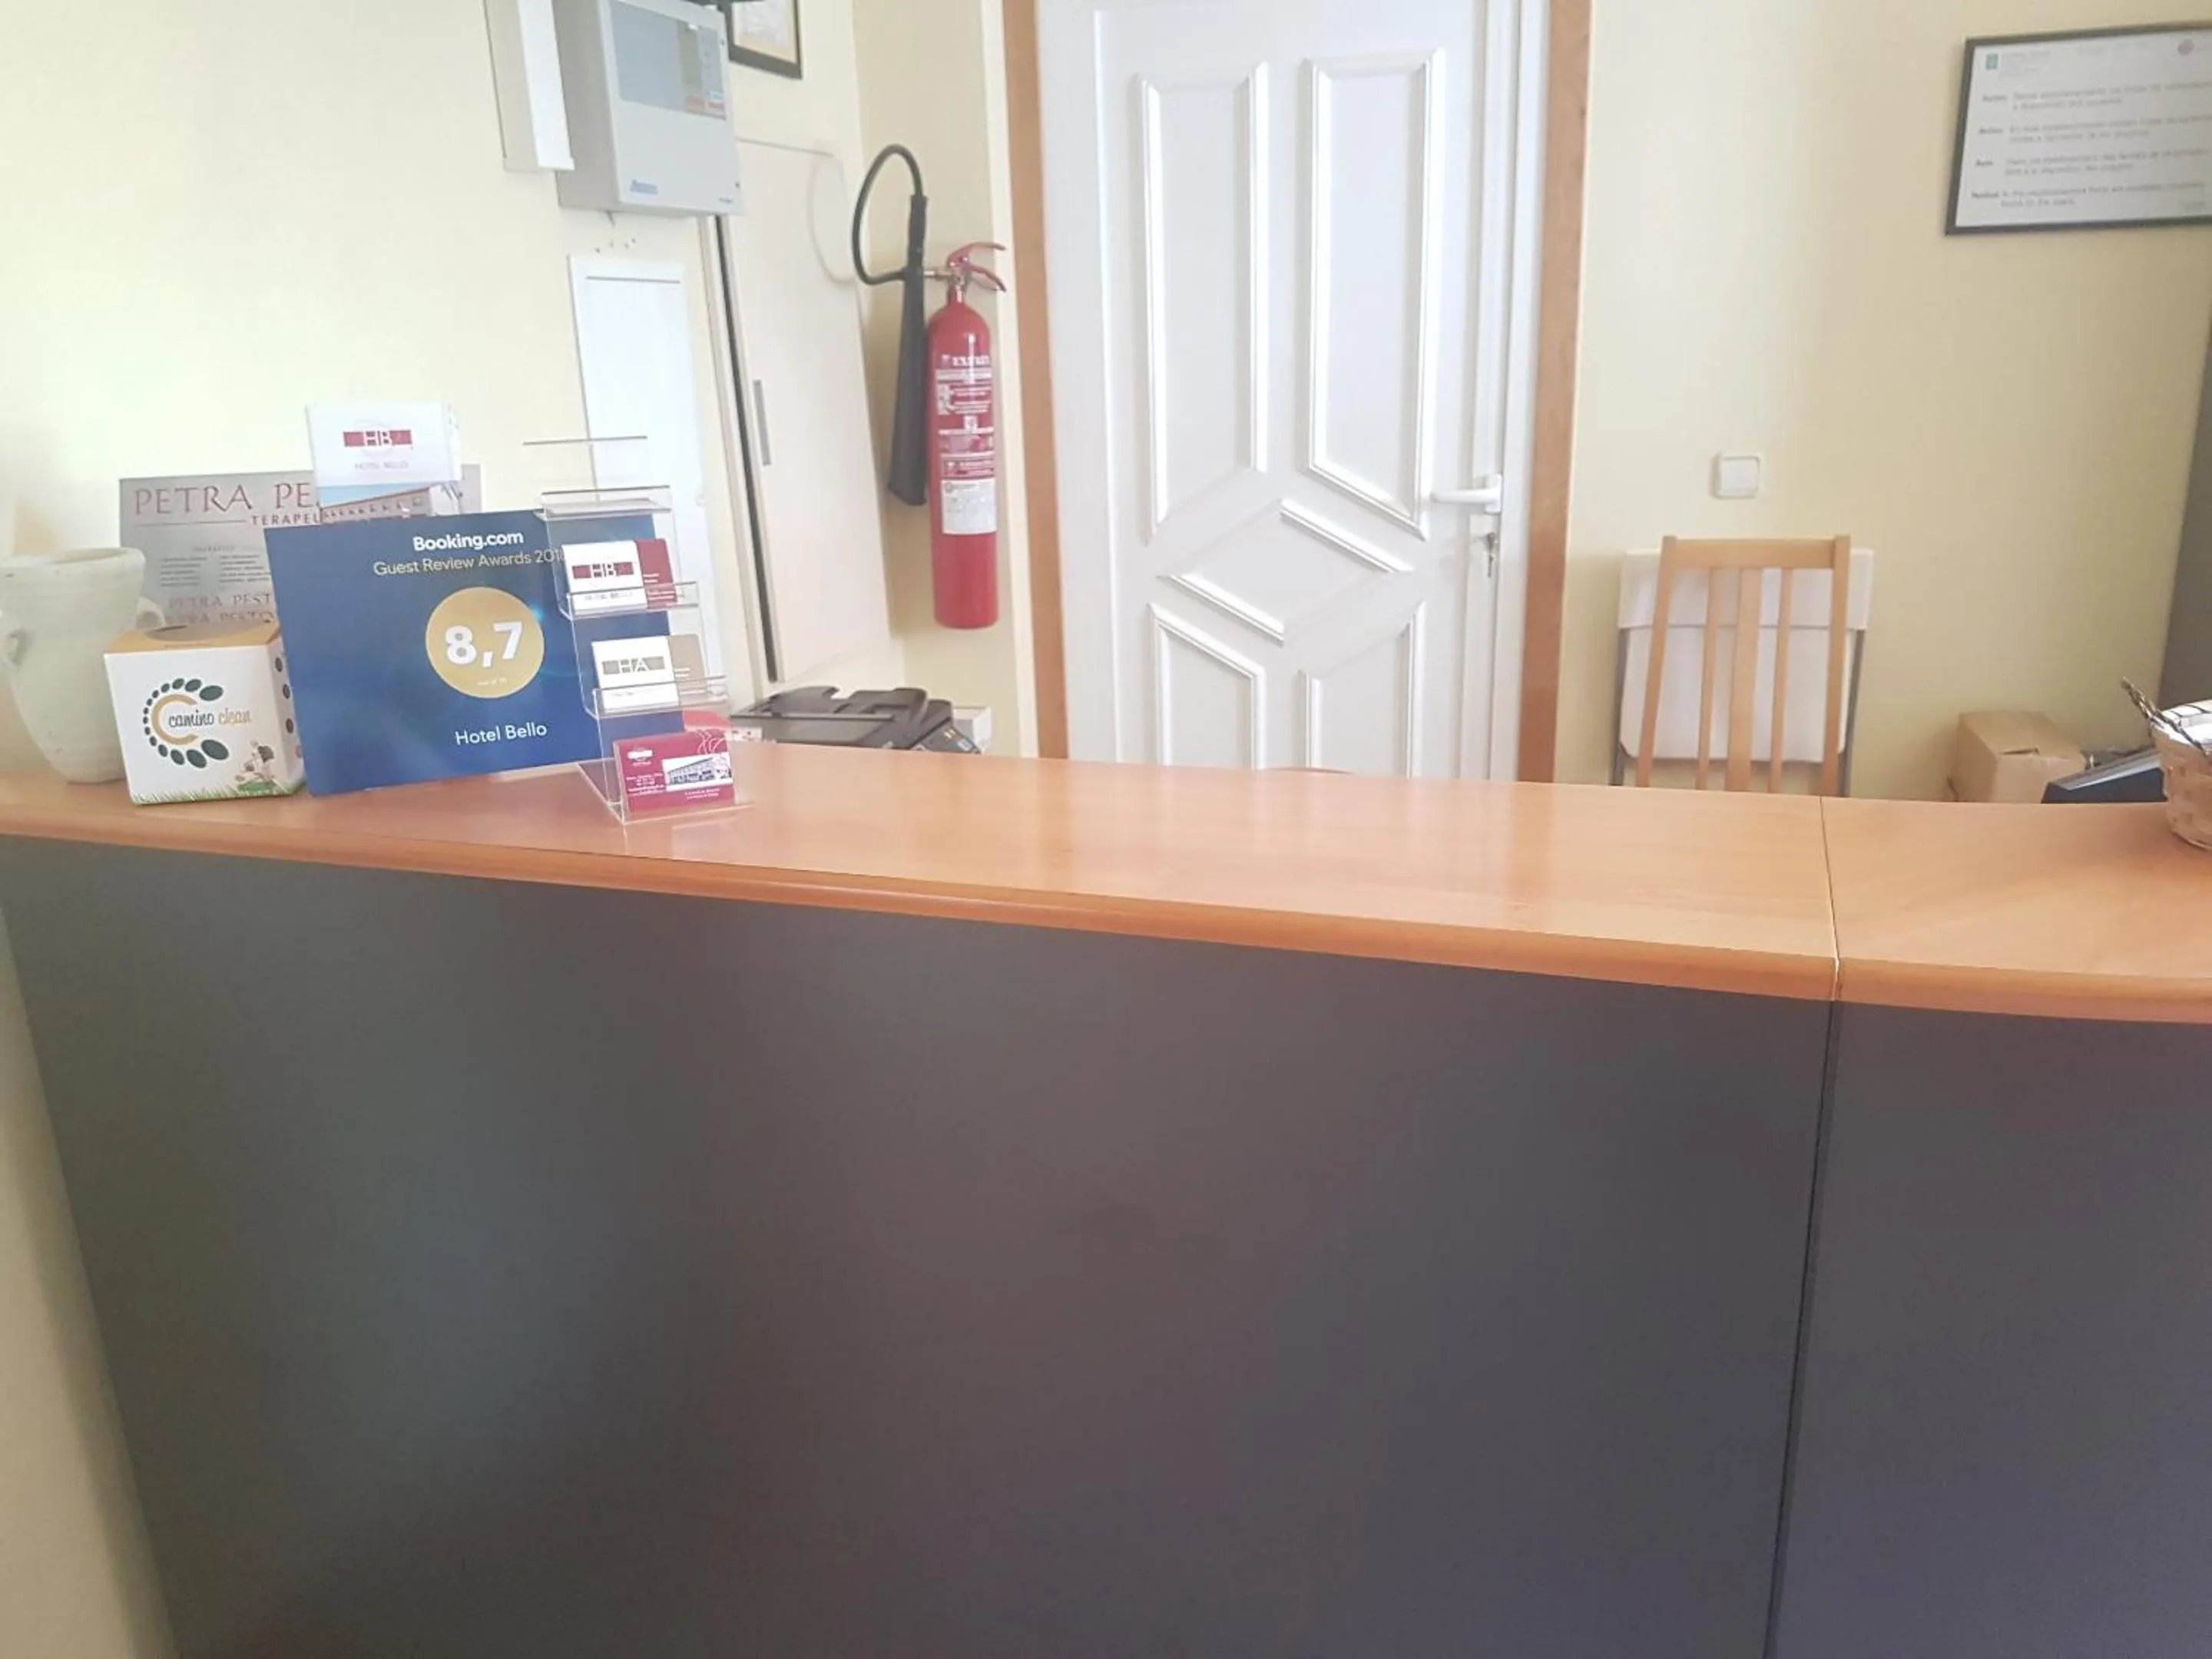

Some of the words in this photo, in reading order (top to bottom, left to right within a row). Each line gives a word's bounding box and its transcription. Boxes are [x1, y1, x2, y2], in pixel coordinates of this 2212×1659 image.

[133, 483, 253, 516] PETRA
[274, 482, 320, 508] PE
[412, 531, 524, 551] Booking.com
[373, 561, 420, 576] Guest
[422, 556, 474, 572] Review
[478, 551, 531, 568] Awards
[445, 621, 522, 667] 8,7
[168, 709, 214, 728] camino
[217, 707, 252, 726] clean
[455, 726, 501, 745] Hotel
[505, 722, 547, 740] Bello
